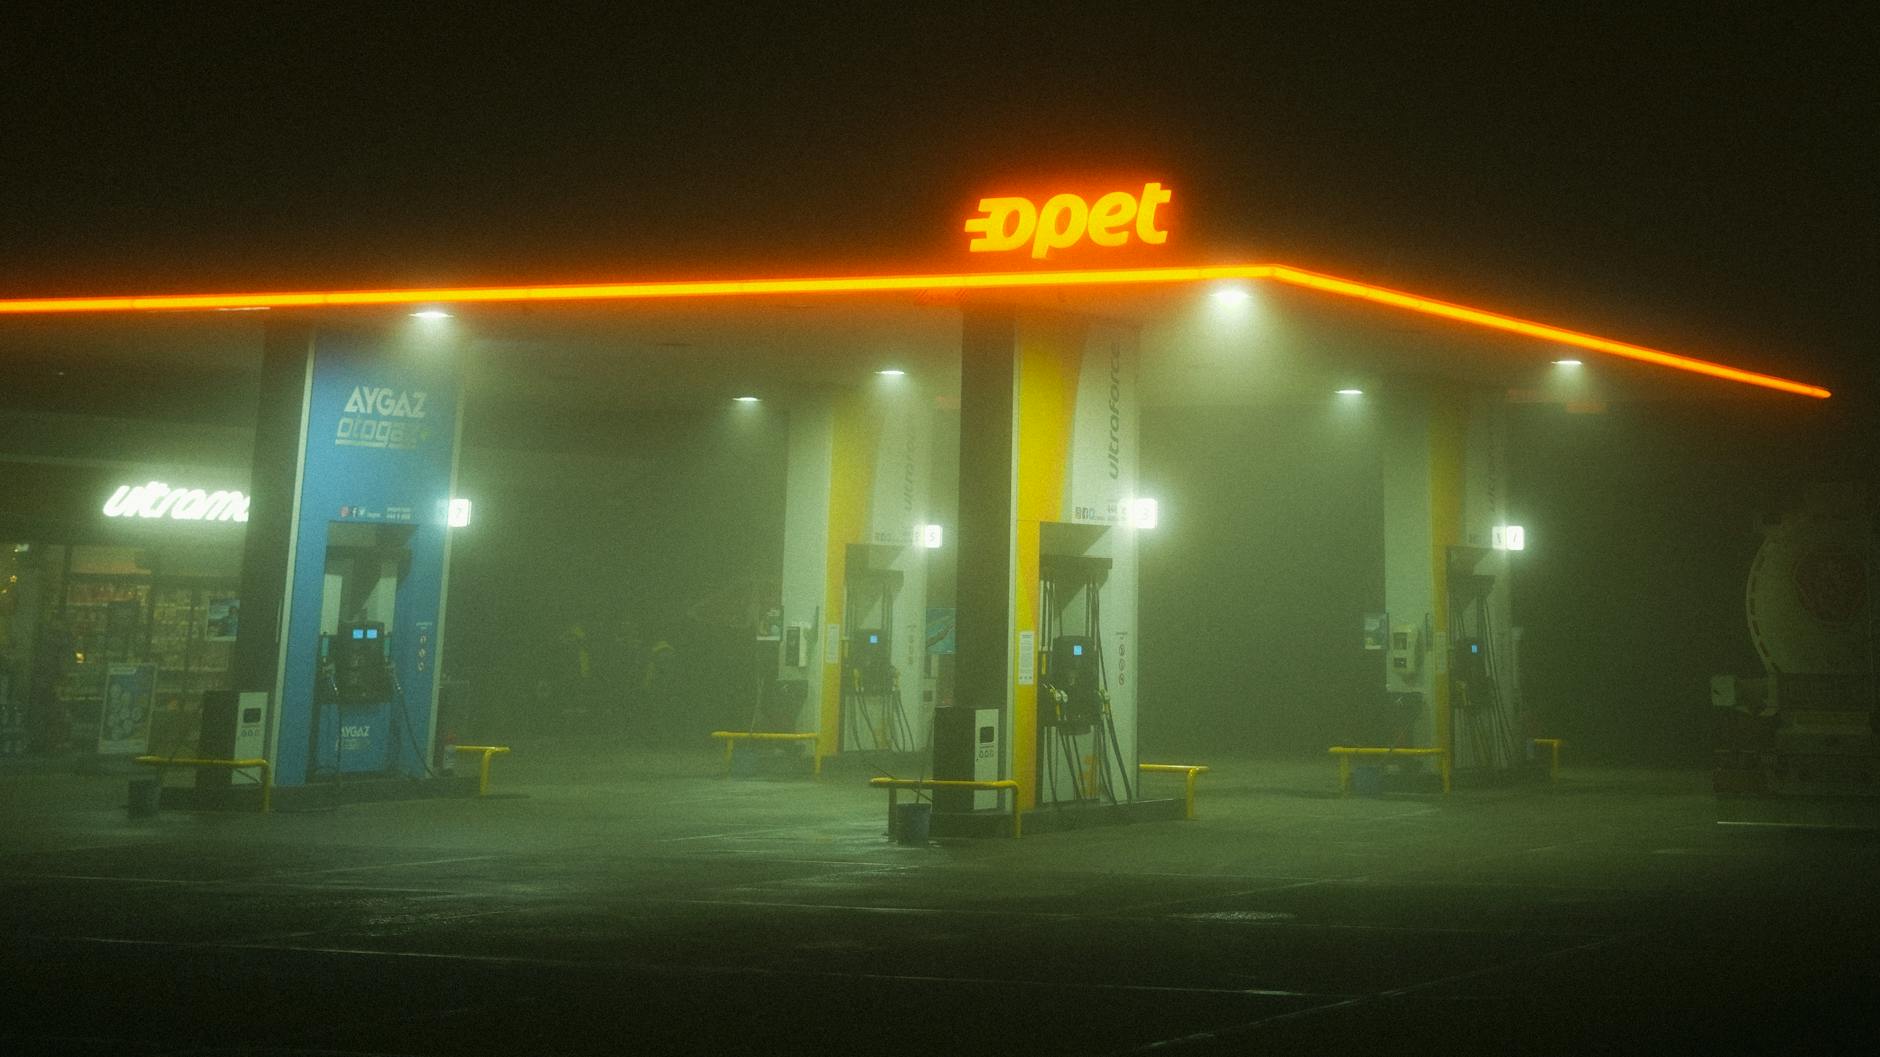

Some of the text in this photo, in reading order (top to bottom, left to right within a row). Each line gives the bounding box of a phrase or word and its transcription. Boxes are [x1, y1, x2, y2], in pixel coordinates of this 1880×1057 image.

[964, 182, 1172, 259] opet
[343, 384, 428, 419] AYGAZ
[1107, 341, 1121, 481] ultraforce
